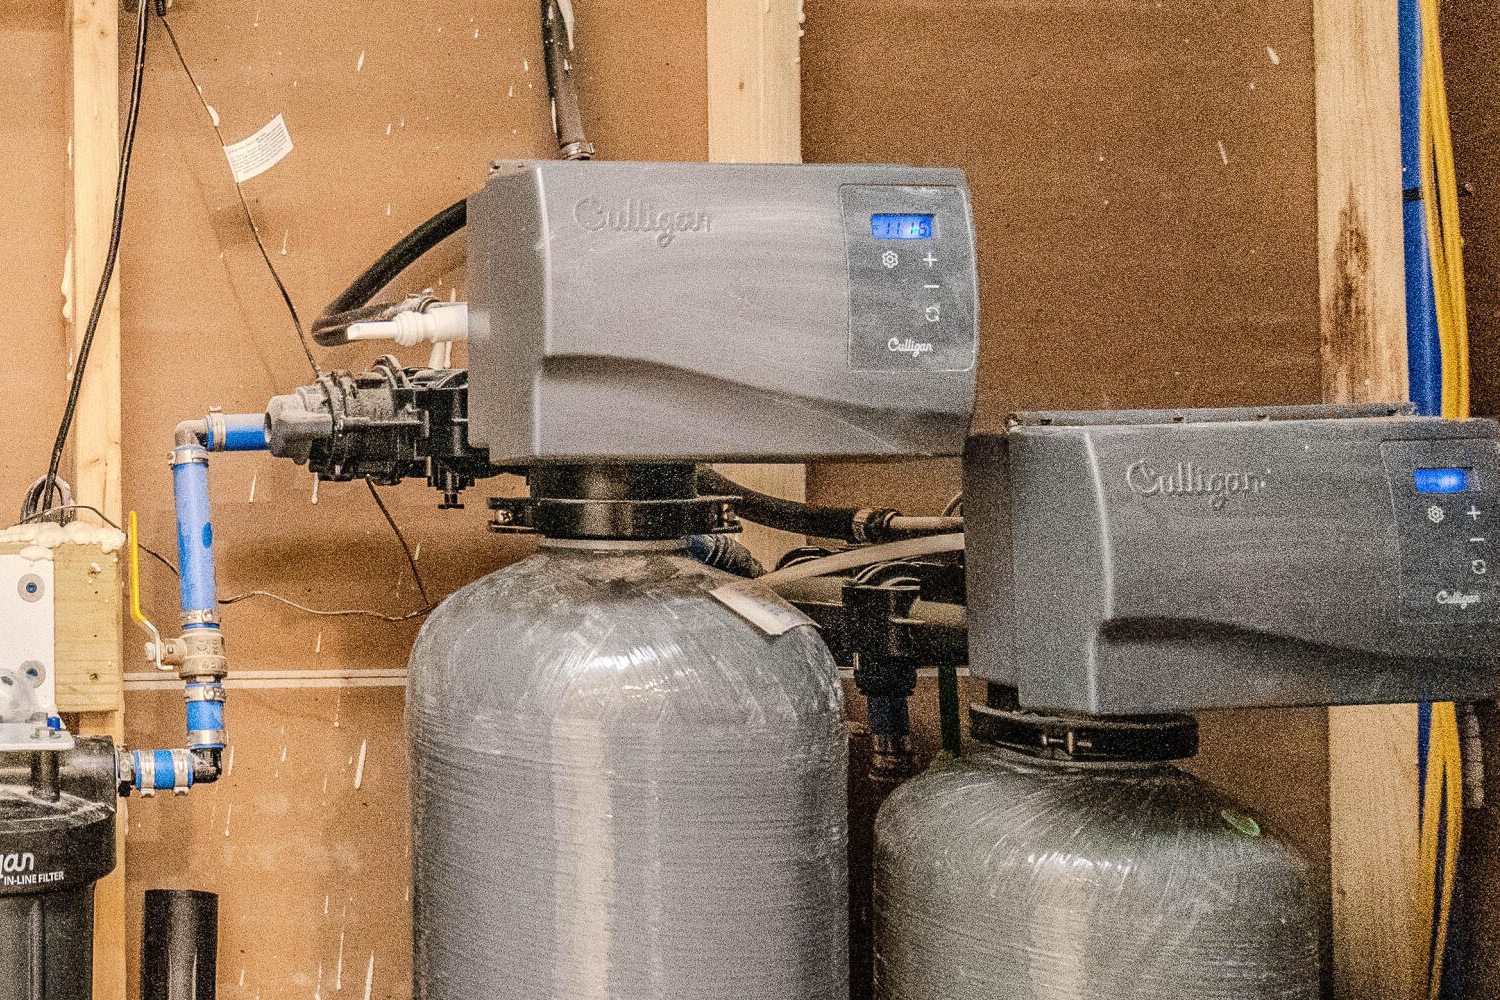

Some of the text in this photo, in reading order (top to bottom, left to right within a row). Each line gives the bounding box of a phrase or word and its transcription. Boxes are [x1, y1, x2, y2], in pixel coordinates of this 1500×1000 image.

[573, 198, 712, 248] Culligan
[888, 336, 932, 358] Culligan
[1126, 460, 1260, 510] Culligan
[3, 873, 37, 886] IN-LINE
[38, 871, 65, 884] FILTER
